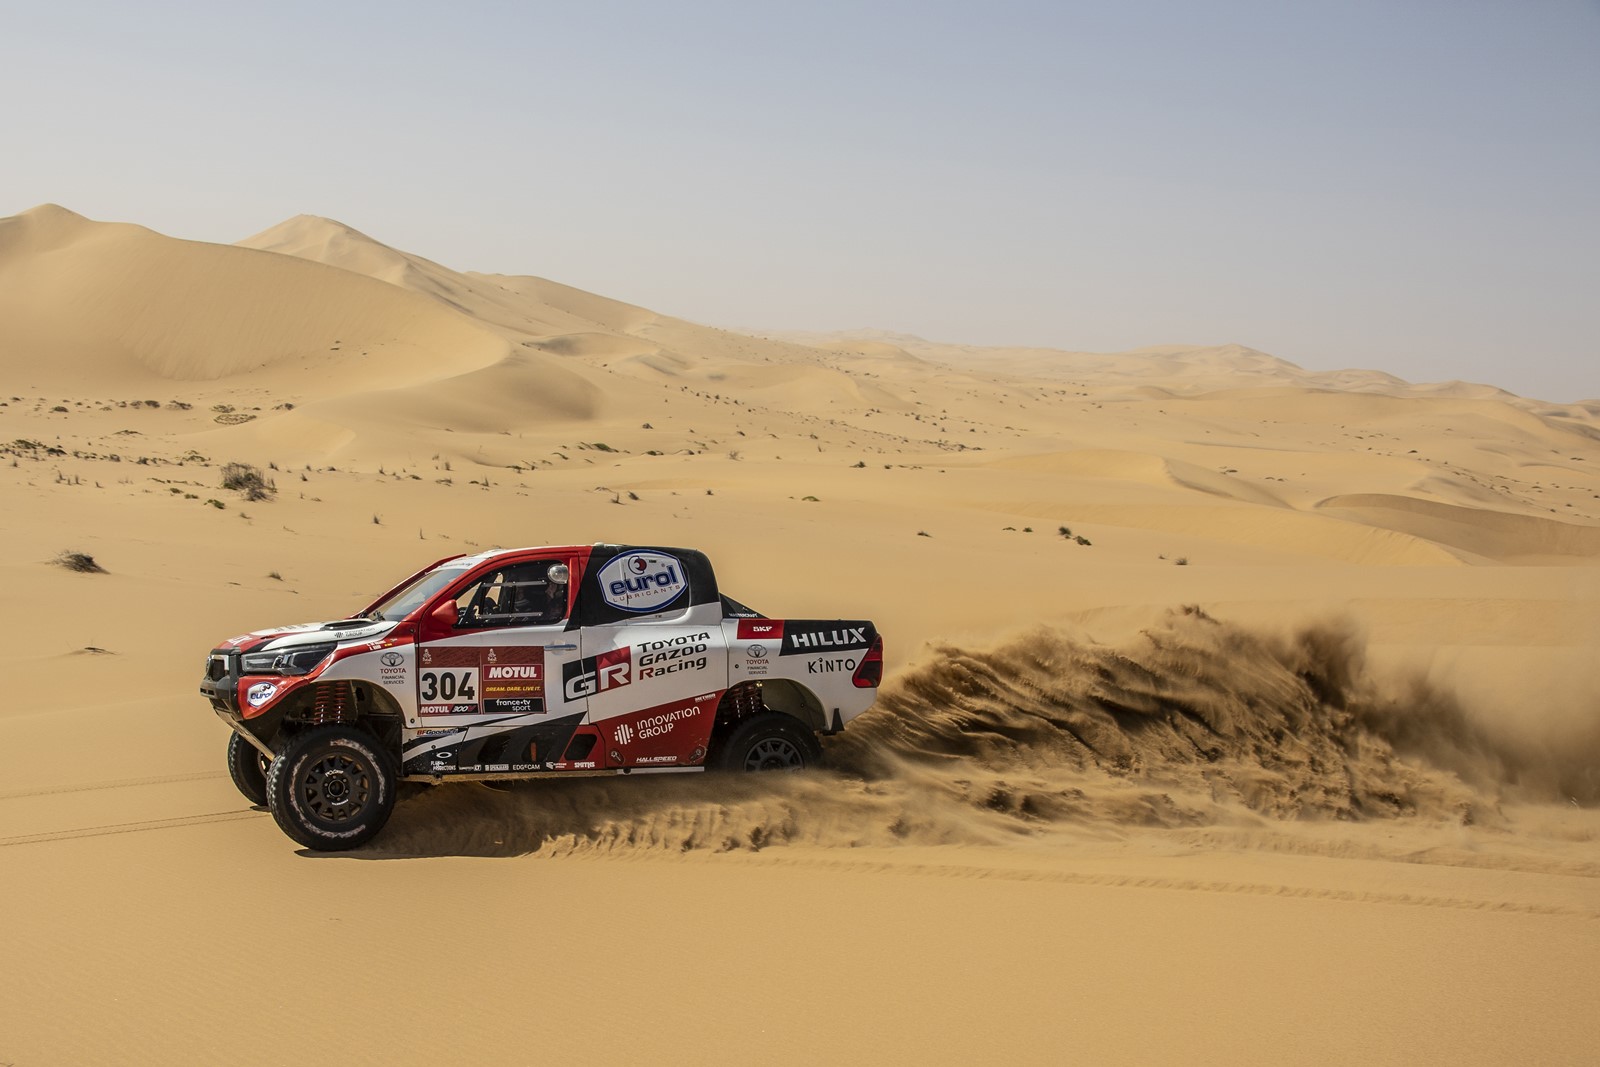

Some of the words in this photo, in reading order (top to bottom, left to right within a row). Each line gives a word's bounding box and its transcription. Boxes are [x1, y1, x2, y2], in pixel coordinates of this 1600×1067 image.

[609, 565, 679, 596] eurol
[613, 585, 681, 602] LUBRICANTS
[637, 632, 711, 653] TOYOTA
[791, 627, 866, 648] HILUX
[639, 644, 707, 667] GAZOO
[488, 666, 537, 679] MOTUL
[639, 657, 707, 681] Racing
[421, 672, 475, 701] 304
[565, 662, 630, 700] GR
[250, 690, 274, 700] eurol
[421, 705, 450, 714] MOTUL
[636, 706, 702, 730] INNOVATION
[638, 723, 675, 739] GROUP
[636, 755, 678, 763] HALLSPEED
